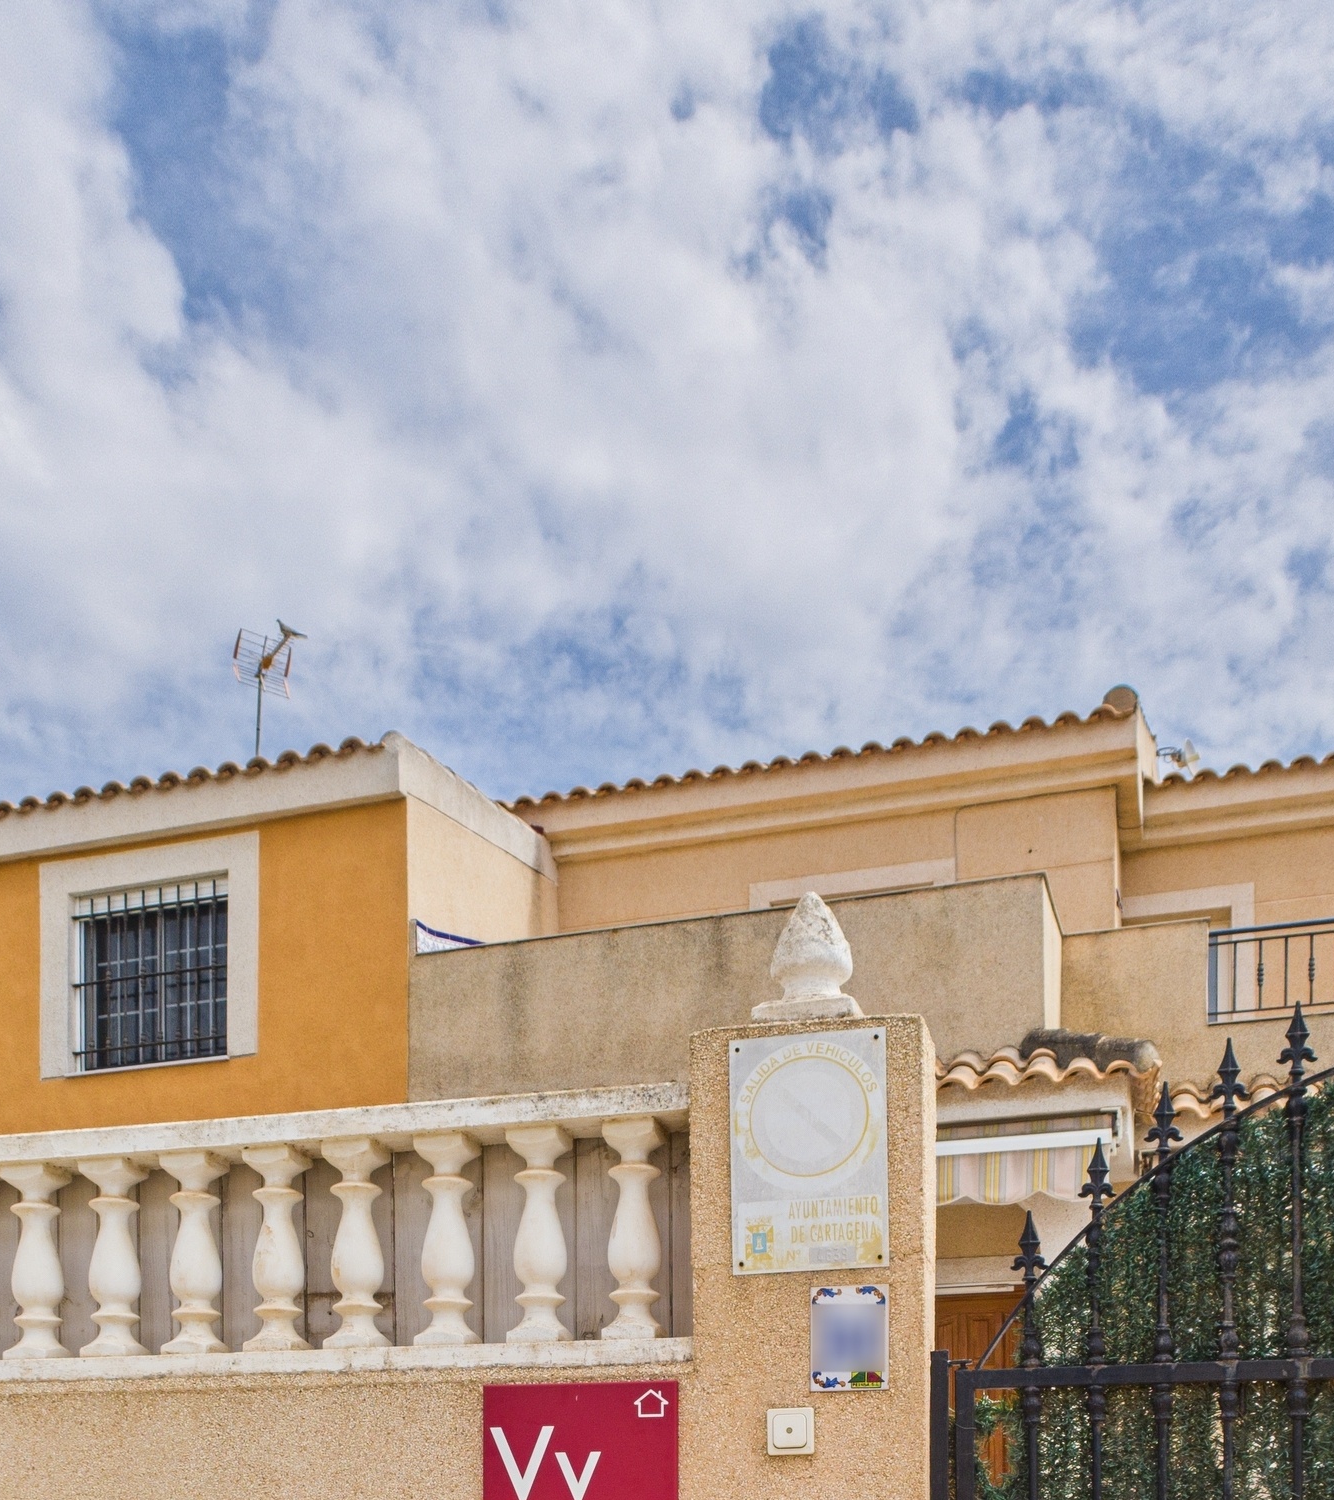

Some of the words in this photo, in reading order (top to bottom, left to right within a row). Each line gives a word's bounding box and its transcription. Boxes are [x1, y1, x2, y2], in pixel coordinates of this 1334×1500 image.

[740, 1056, 780, 1104] SALIDA
[783, 1045, 802, 1061] DE
[806, 1041, 878, 1093] VEHICULOS
[788, 1196, 878, 1220] AYUNTAMIENTO
[791, 1225, 805, 1244] DE
[810, 1221, 877, 1242] CARTAGENA
